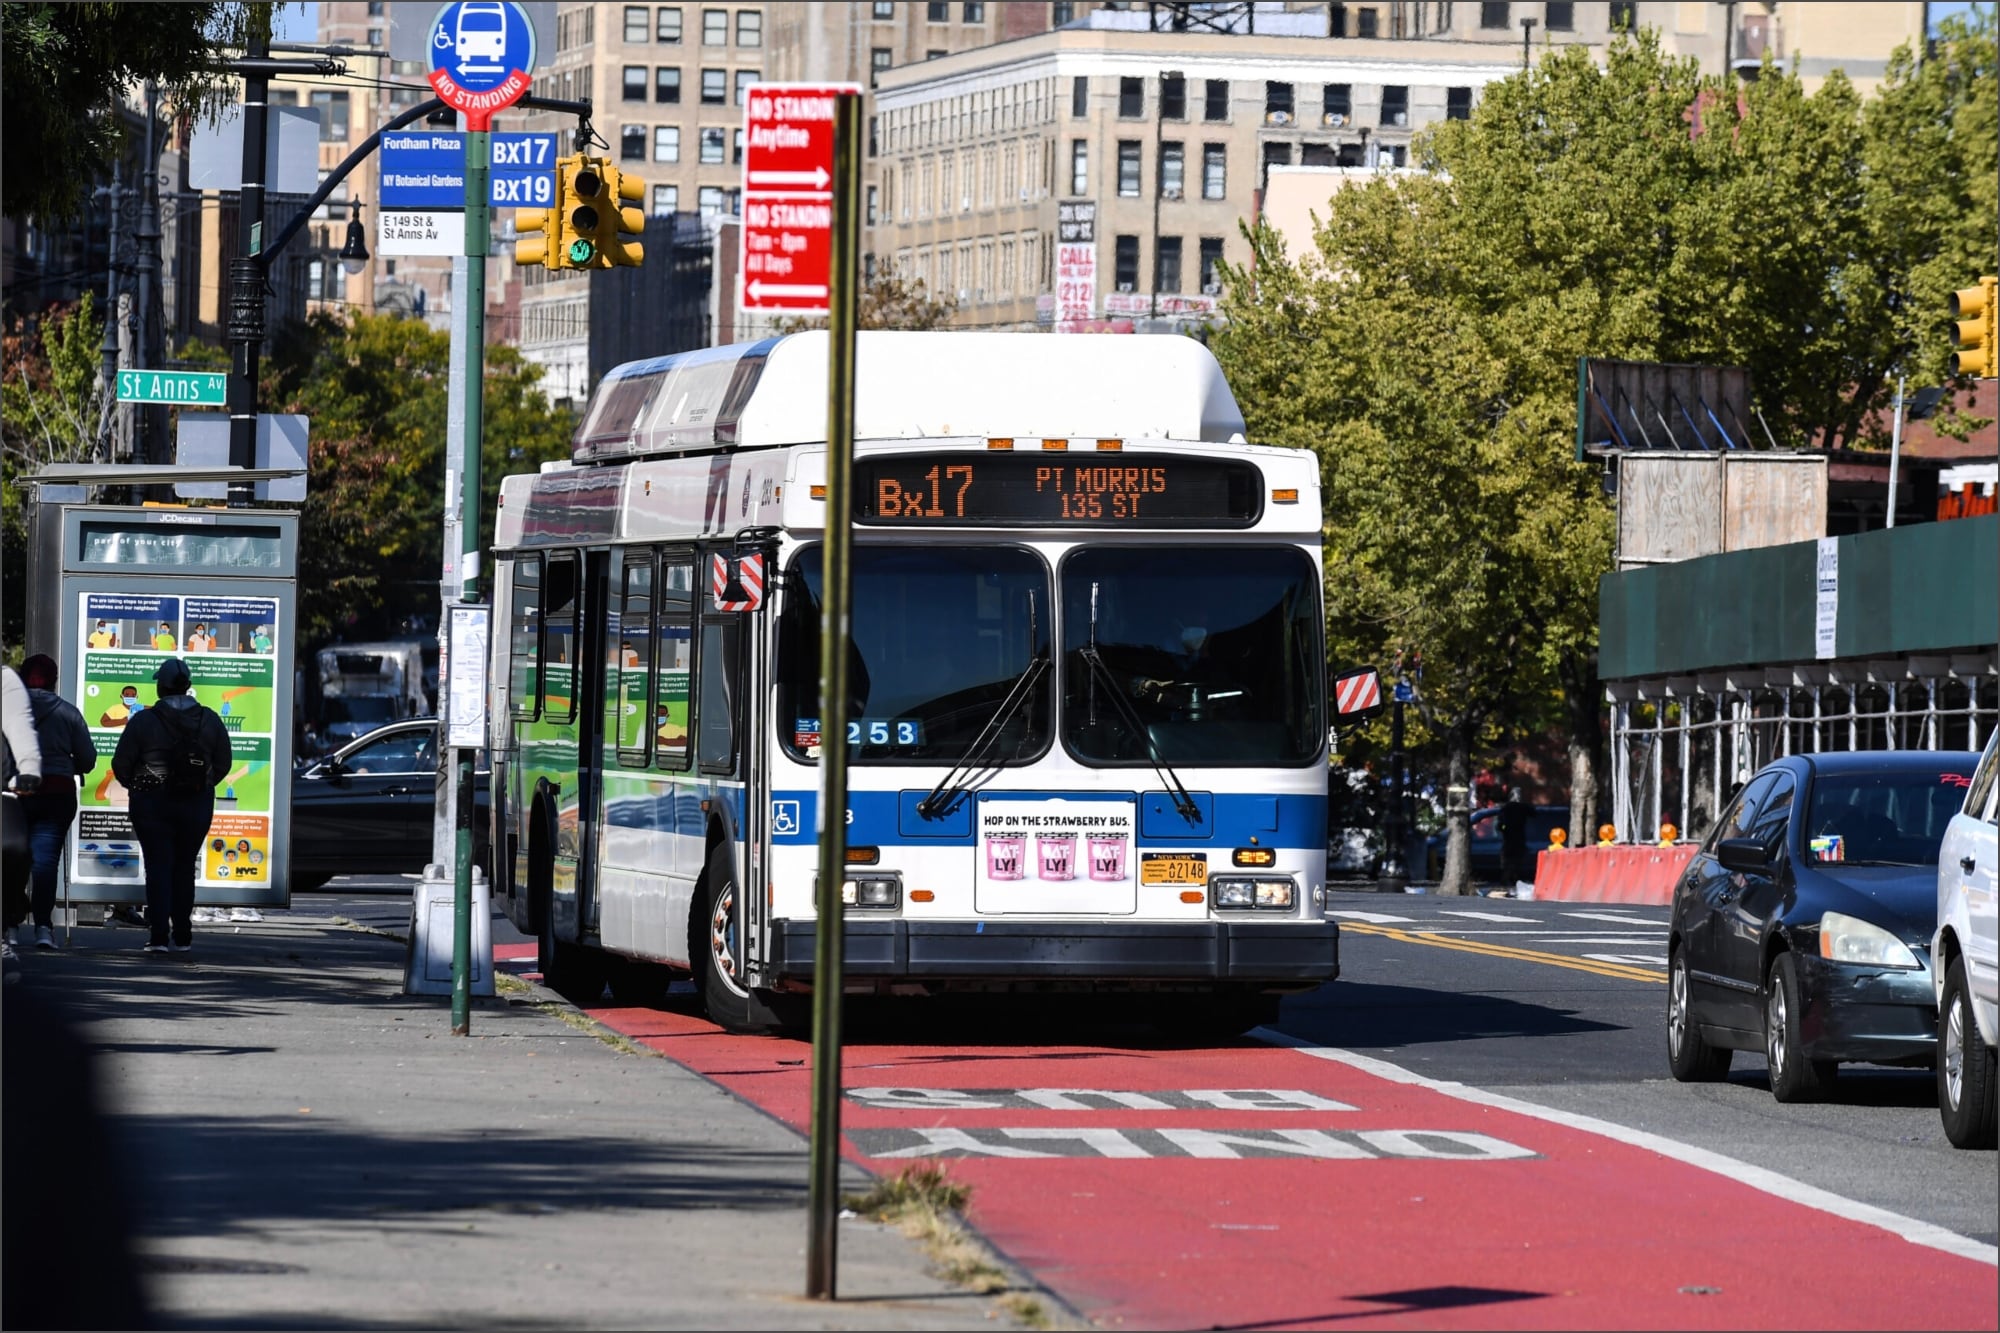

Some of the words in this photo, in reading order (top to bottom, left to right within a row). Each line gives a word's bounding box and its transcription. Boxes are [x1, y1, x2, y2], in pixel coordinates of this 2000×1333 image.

[436, 75, 454, 96] NO
[455, 76, 522, 108] STANDING
[750, 97, 773, 120] NO
[774, 97, 834, 120] STANDIN
[384, 137, 429, 149] Fordham
[432, 137, 460, 149] Plaza
[750, 124, 810, 152] Anytime
[493, 138, 550, 164] BX17
[384, 175, 394, 186] NY
[396, 175, 430, 186] Botanical
[432, 175, 463, 186] Gardens
[493, 176, 550, 202] BX19
[384, 216, 389, 226] E
[393, 216, 410, 226] 149
[413, 216, 423, 226] St
[426, 216, 433, 226] &
[748, 204, 769, 228] NO
[770, 204, 831, 228] STANDIN
[384, 228, 394, 239] St
[397, 228, 422, 239] Anns
[425, 229, 438, 239] Av
[748, 231, 772, 251] 7am
[781, 232, 807, 255] 8pm
[748, 253, 763, 272] All
[765, 253, 793, 277] Days
[1060, 248, 1092, 265] CALL
[122, 374, 141, 398] St
[150, 375, 199, 399] Anns
[208, 377, 222, 389] Av
[879, 465, 973, 517] Bx17
[1036, 468, 1064, 492] PT
[1075, 468, 1165, 492] MORRIS
[1062, 494, 1102, 518] 135
[1112, 494, 1140, 518] ST
[159, 514, 203, 523] JCDecaux
[161, 539, 181, 548] city
[984, 816, 1003, 826] HOP
[1006, 816, 1019, 826] ON
[1022, 816, 1041, 826] THE
[1043, 816, 1107, 826] STRAWBERRY
[1110, 816, 1130, 826] BUS.
[236, 867, 258, 875] NYC
[995, 858, 1016, 871] LY!
[1046, 858, 1066, 872] LY!
[1096, 859, 1117, 872] LY!
[847, 1087, 1362, 1112] BUS
[870, 1128, 1538, 1160] ONLY
